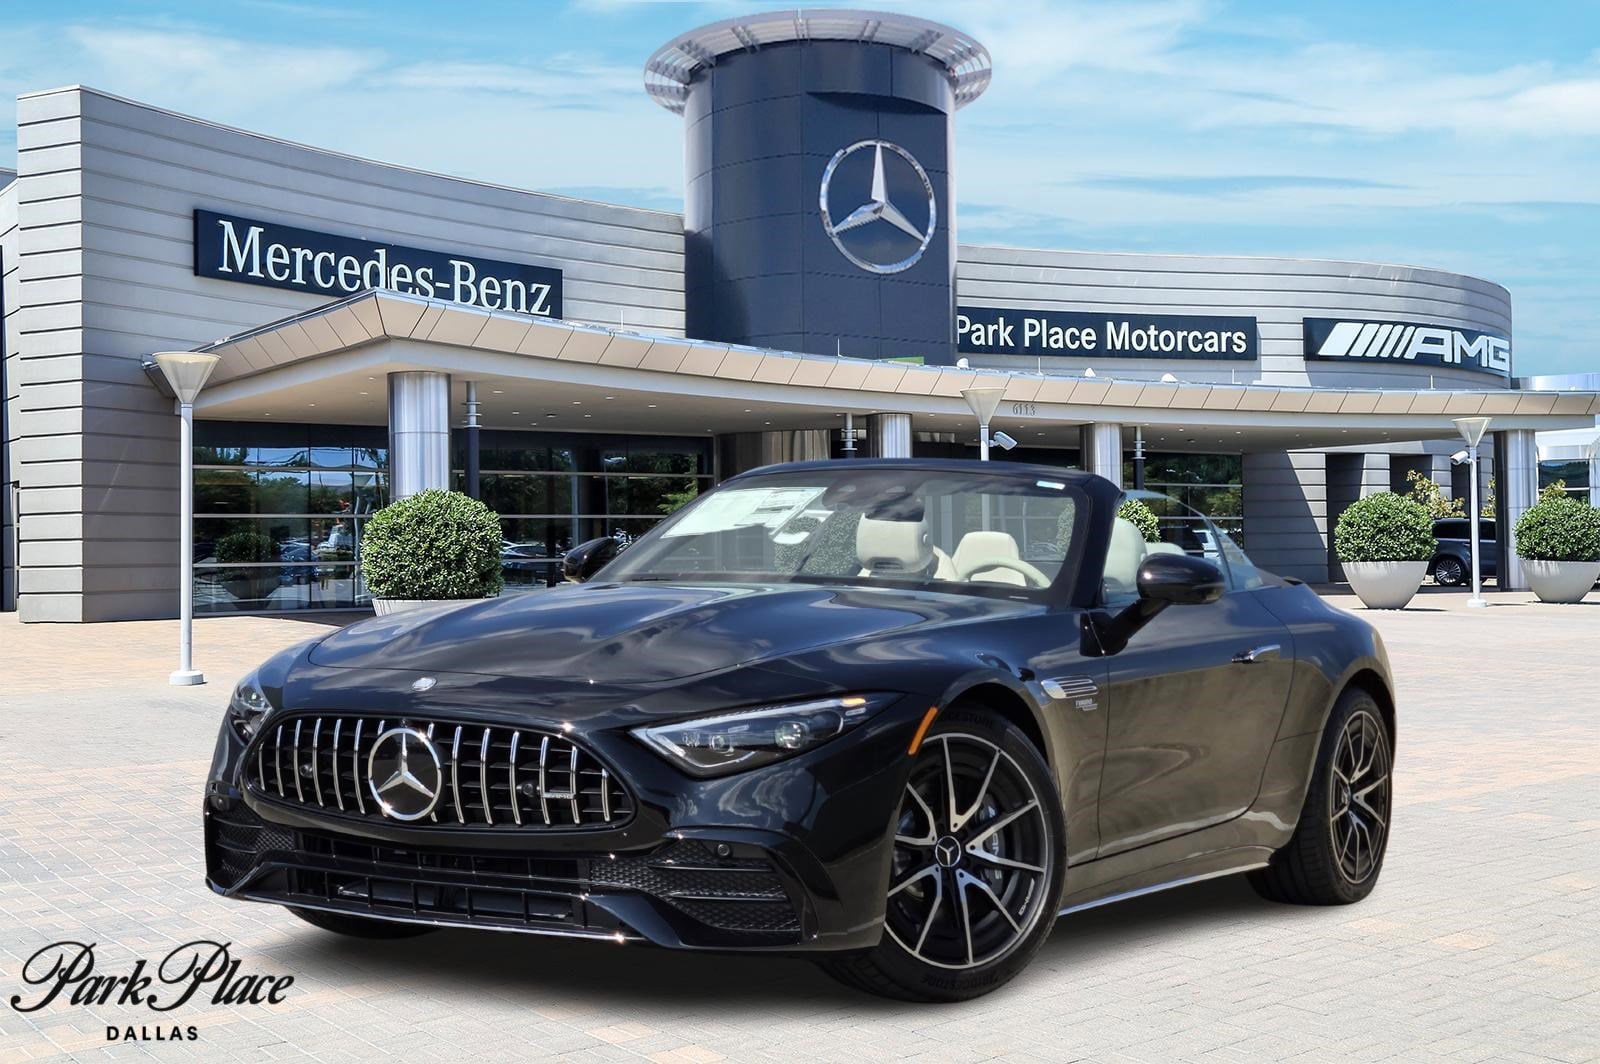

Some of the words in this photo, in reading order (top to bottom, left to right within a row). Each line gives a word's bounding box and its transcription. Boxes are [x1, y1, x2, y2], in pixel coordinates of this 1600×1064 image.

[217, 219, 552, 317] Mercedes-Benz
[956, 315, 1015, 348] Park
[1023, 317, 1098, 351] Place
[1106, 321, 1248, 355] Motorcars
[1400, 326, 1510, 372] AMG
[1012, 402, 1036, 417] 6113
